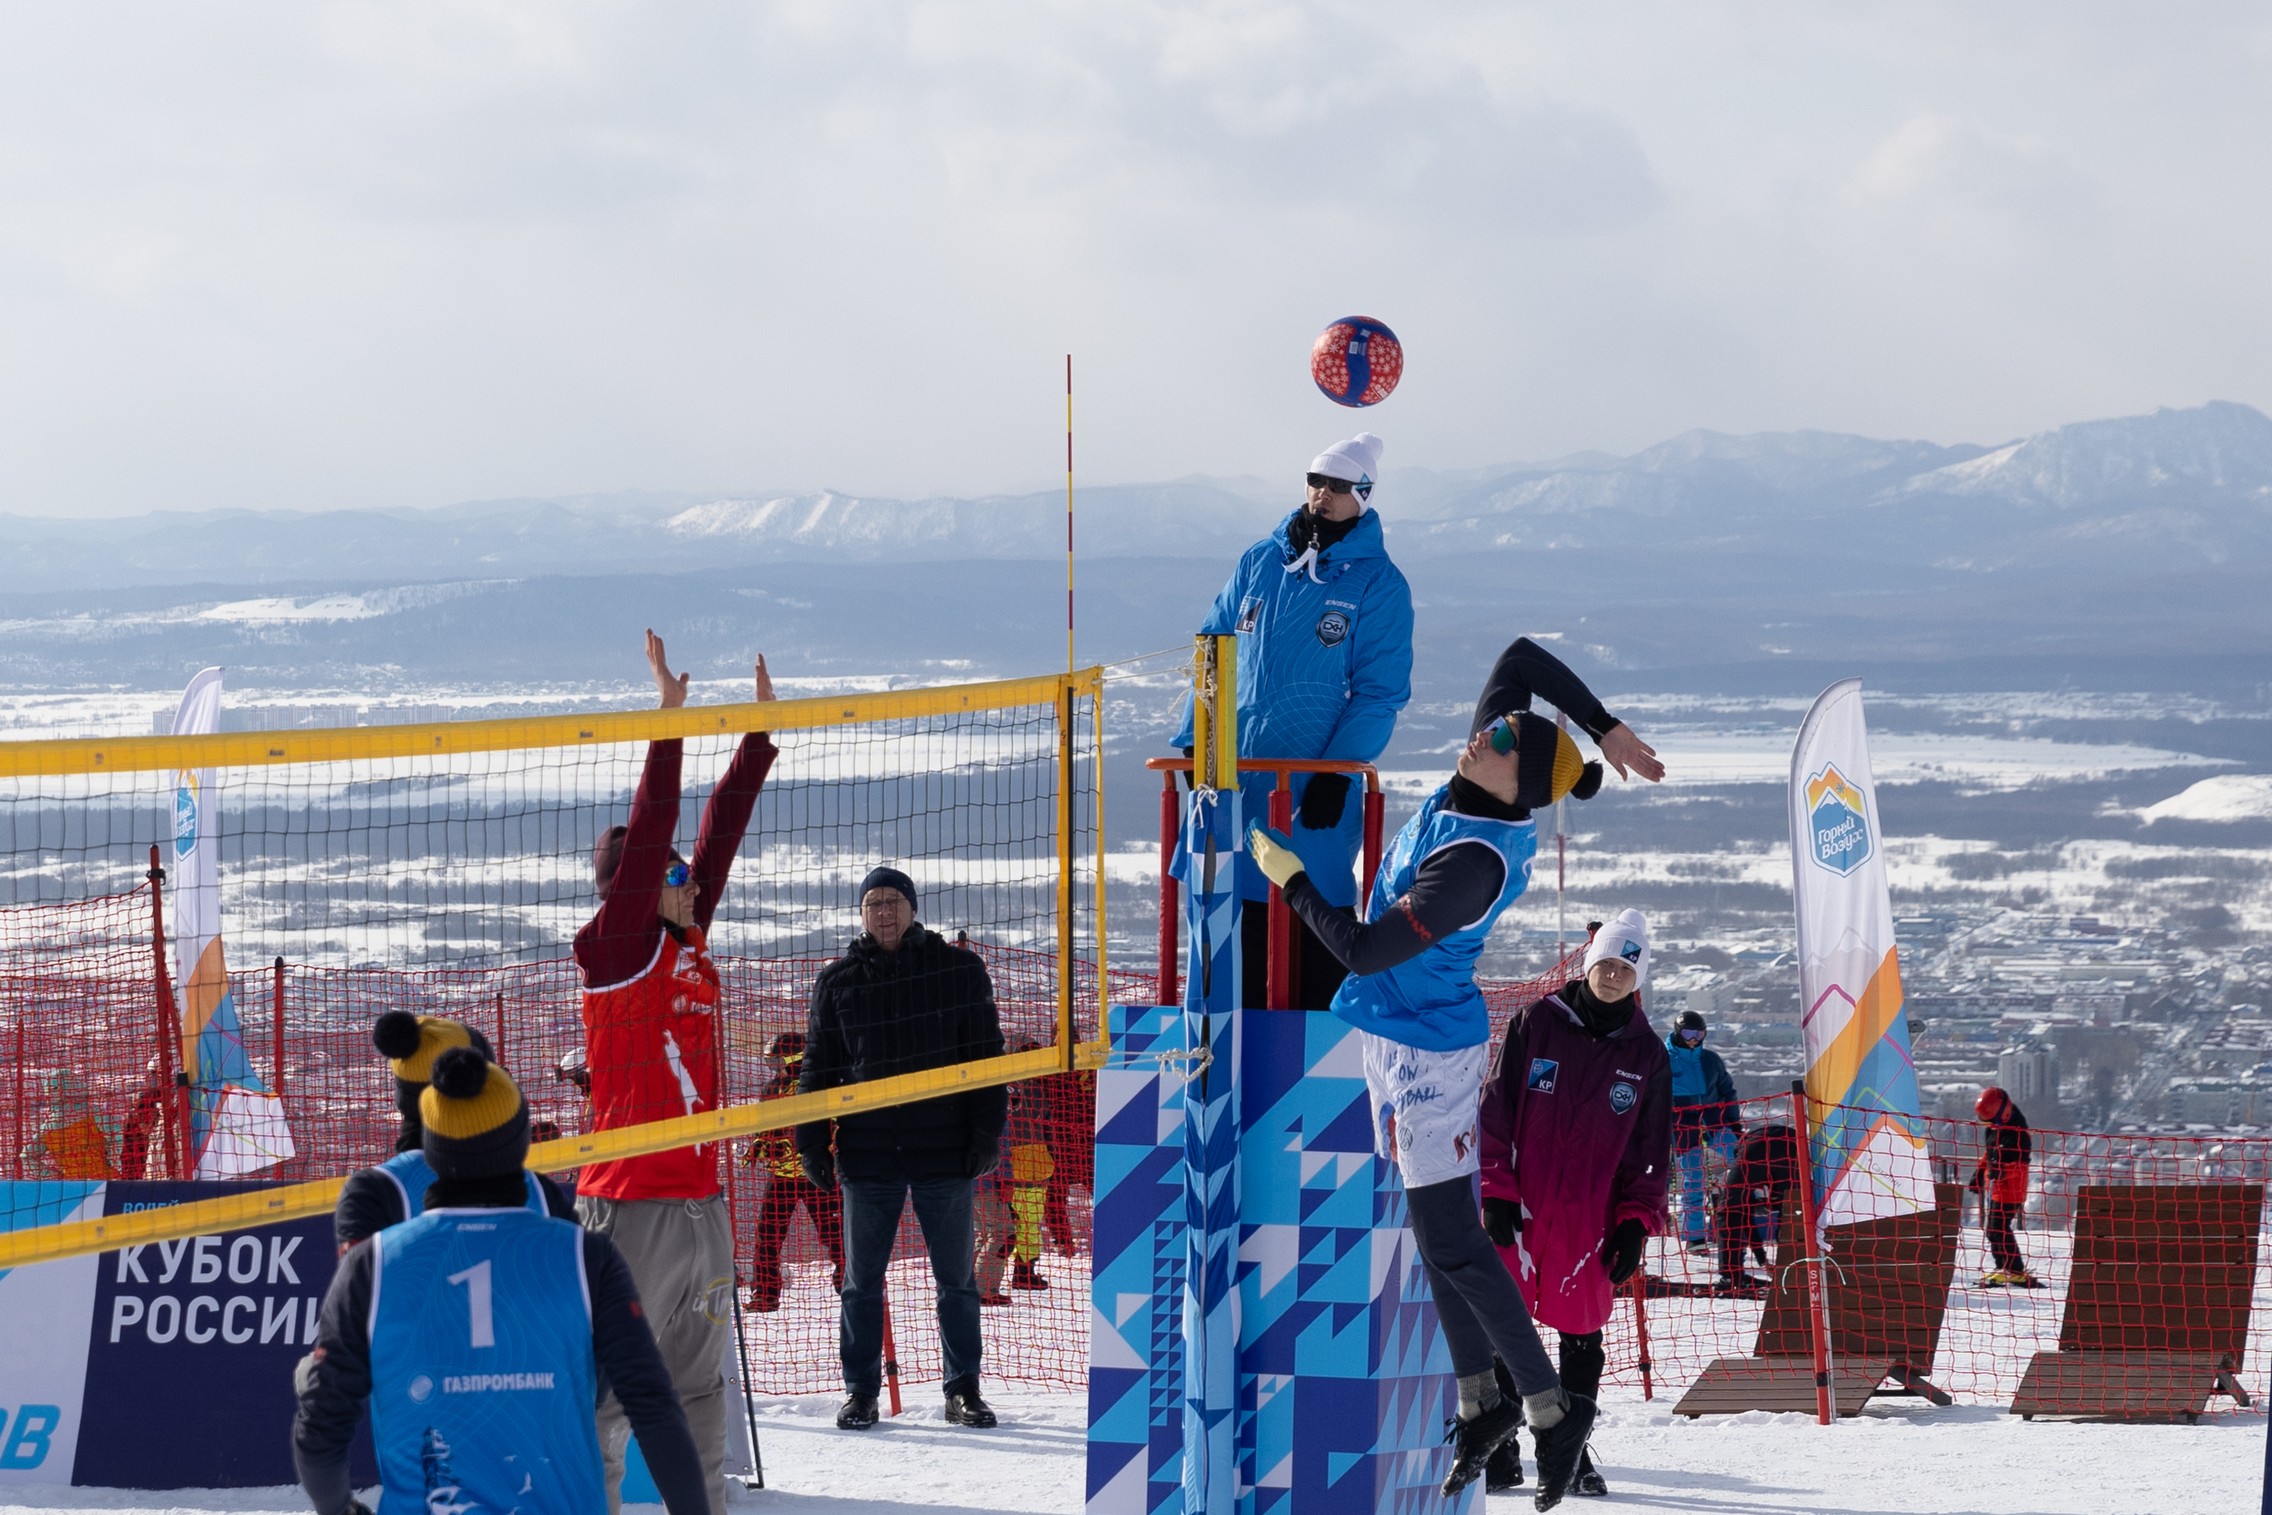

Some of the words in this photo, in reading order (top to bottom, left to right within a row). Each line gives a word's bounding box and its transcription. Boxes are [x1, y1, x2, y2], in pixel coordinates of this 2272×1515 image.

[1821, 828, 1865, 860] Возух
[116, 1235, 304, 1284] КУБОК
[447, 1259, 496, 1348] 1
[442, 1372, 555, 1394] ГАЗПРОМБАНК
